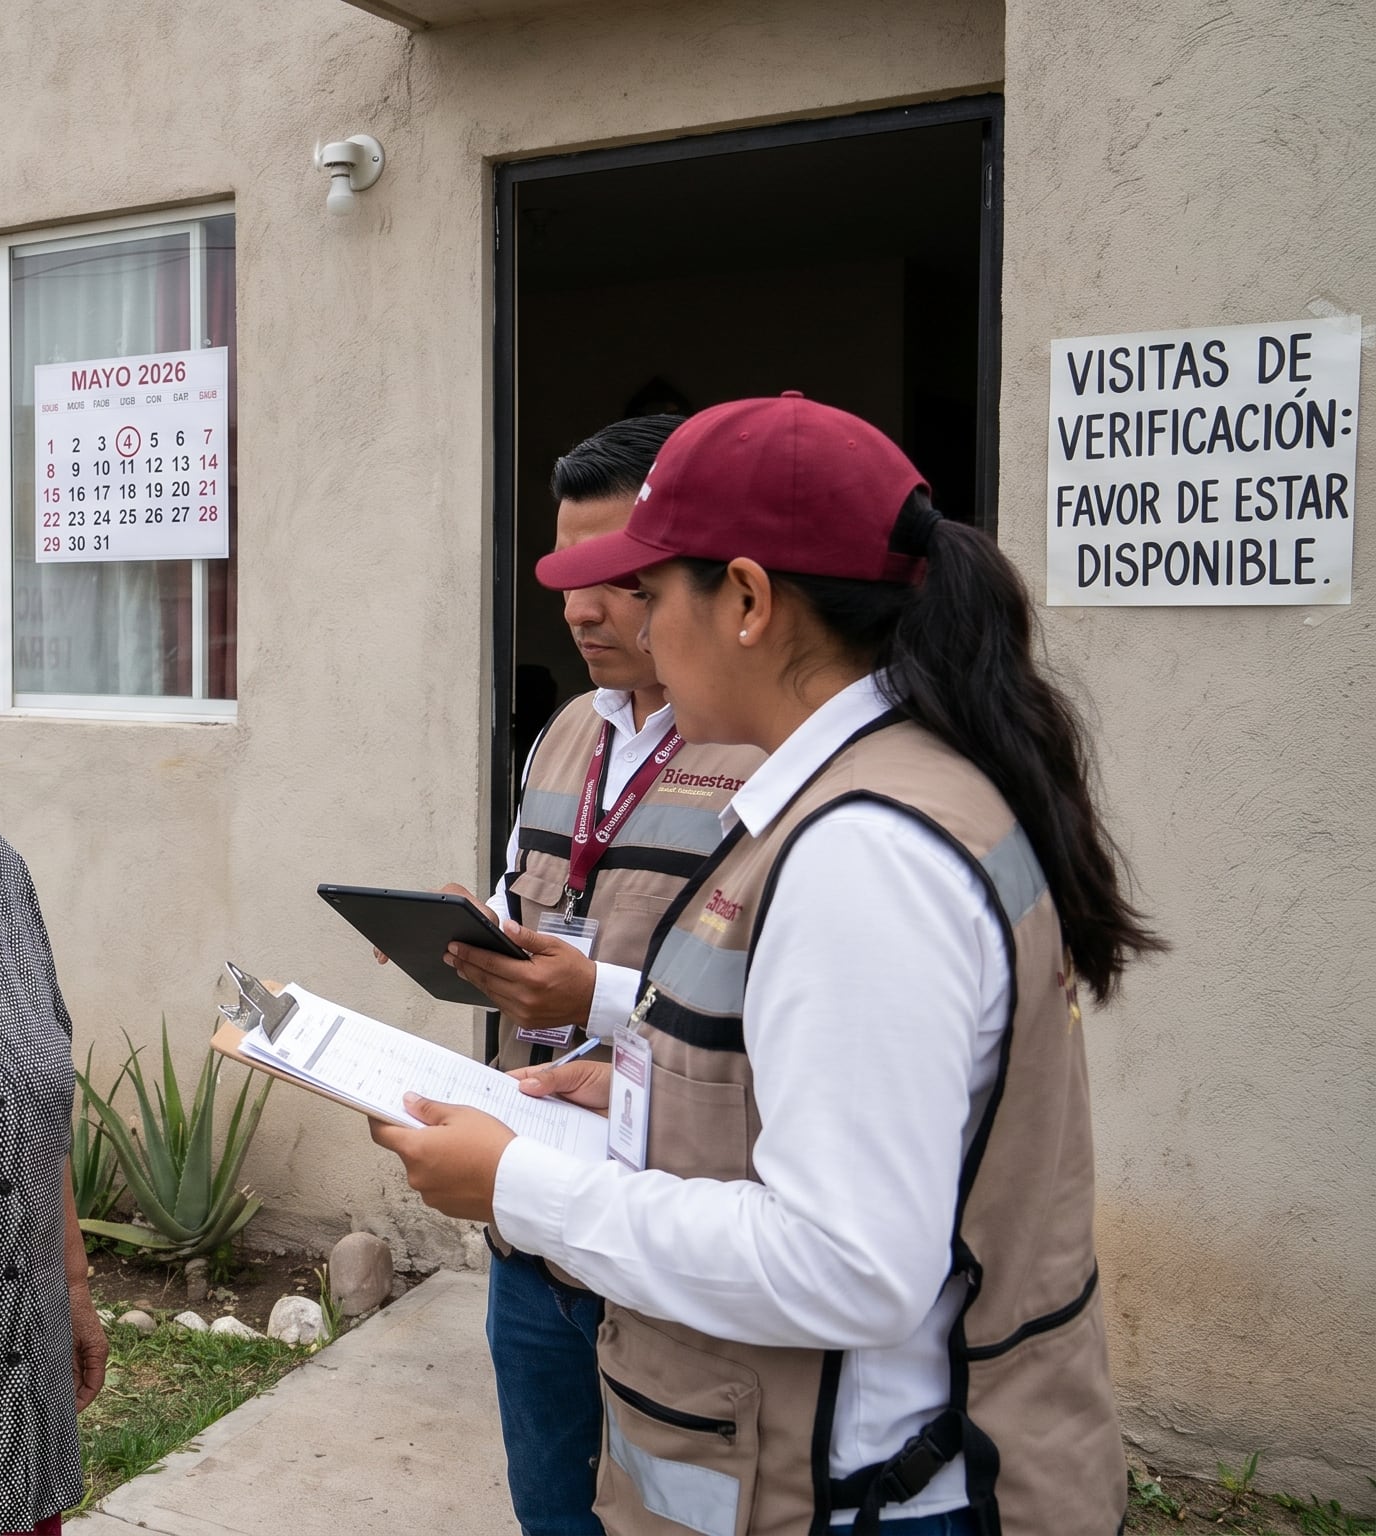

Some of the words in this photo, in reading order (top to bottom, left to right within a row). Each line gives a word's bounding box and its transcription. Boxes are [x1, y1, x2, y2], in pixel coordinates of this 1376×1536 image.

[71, 366, 130, 391] MAYO
[138, 361, 186, 385] 2026
[1067, 340, 1229, 396] VISITAS
[1258, 333, 1312, 384] DE
[1058, 387, 1352, 460] VERIFICACIÓN:
[47, 440, 53, 454] 1
[72, 438, 80, 452] 2
[98, 436, 106, 451] 3
[124, 434, 132, 449] 4
[150, 432, 158, 447] 5
[176, 431, 184, 446] 6
[203, 429, 213, 444] 7
[47, 464, 55, 478] 8
[72, 462, 80, 477] 9
[93, 461, 110, 476] 10
[120, 459, 134, 474] 11
[146, 458, 162, 473] 12
[172, 456, 190, 471] 13
[200, 454, 218, 470] 14
[44, 488, 60, 503] 15
[69, 487, 85, 502] 16
[94, 485, 110, 500] 17
[120, 484, 136, 499] 18
[146, 482, 162, 498] 19
[172, 481, 189, 497] 20
[199, 480, 216, 496] 21
[1057, 482, 1161, 527] FAVOR
[1177, 479, 1219, 523] DE
[1235, 473, 1349, 522] ESTAR
[43, 512, 60, 527] 22
[68, 511, 85, 526] 23
[94, 510, 110, 525] 24
[119, 509, 136, 524] 25
[145, 508, 163, 523] 26
[172, 507, 190, 522] 27
[199, 506, 218, 522] 28
[44, 537, 60, 551] 29
[68, 536, 85, 551] 30
[94, 535, 109, 550] 31
[1078, 538, 1330, 587] DISPONIBLE.
[662, 768, 745, 791] Bienestar
